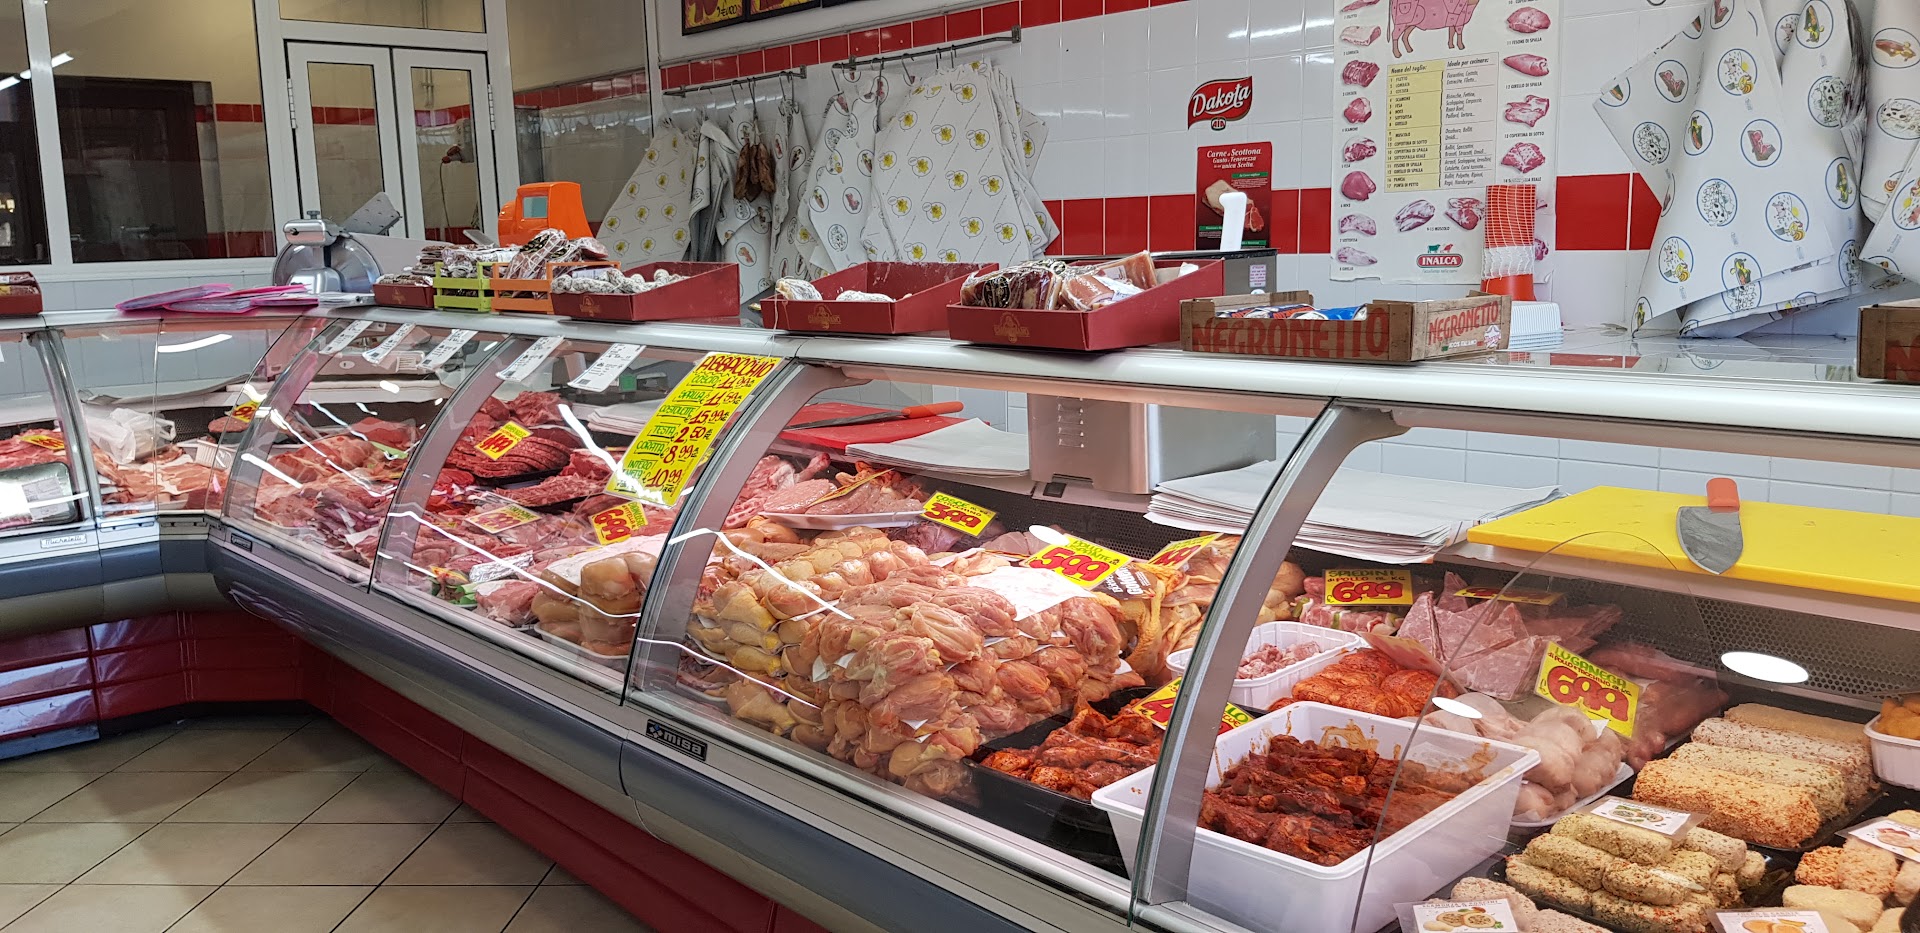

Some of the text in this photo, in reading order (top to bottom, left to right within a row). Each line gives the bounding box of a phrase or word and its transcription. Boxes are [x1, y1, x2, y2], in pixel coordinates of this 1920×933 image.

[1193, 83, 1251, 117] Dakota
[1207, 150, 1227, 158] Carne
[1422, 257, 1458, 265] INALCA
[1428, 300, 1499, 346] NEGRONETTO
[1192, 307, 1390, 359] NEGRONETTO
[696, 355, 775, 378] ABBACCHIO
[692, 375, 719, 384] COSCIO
[679, 390, 705, 399] SPALLA
[653, 425, 677, 435] TESTA
[636, 441, 665, 453] CORATA
[627, 460, 652, 469] INTERO
[936, 495, 970, 508] COSCE
[1073, 540, 1103, 552] POLLO
[1328, 570, 1394, 578] SPIEDINI
[1554, 656, 1573, 668] POLLO
[1577, 668, 1611, 687] TACCHINO
[1555, 647, 1627, 687] LUGANEGA
[663, 731, 702, 755] misa
